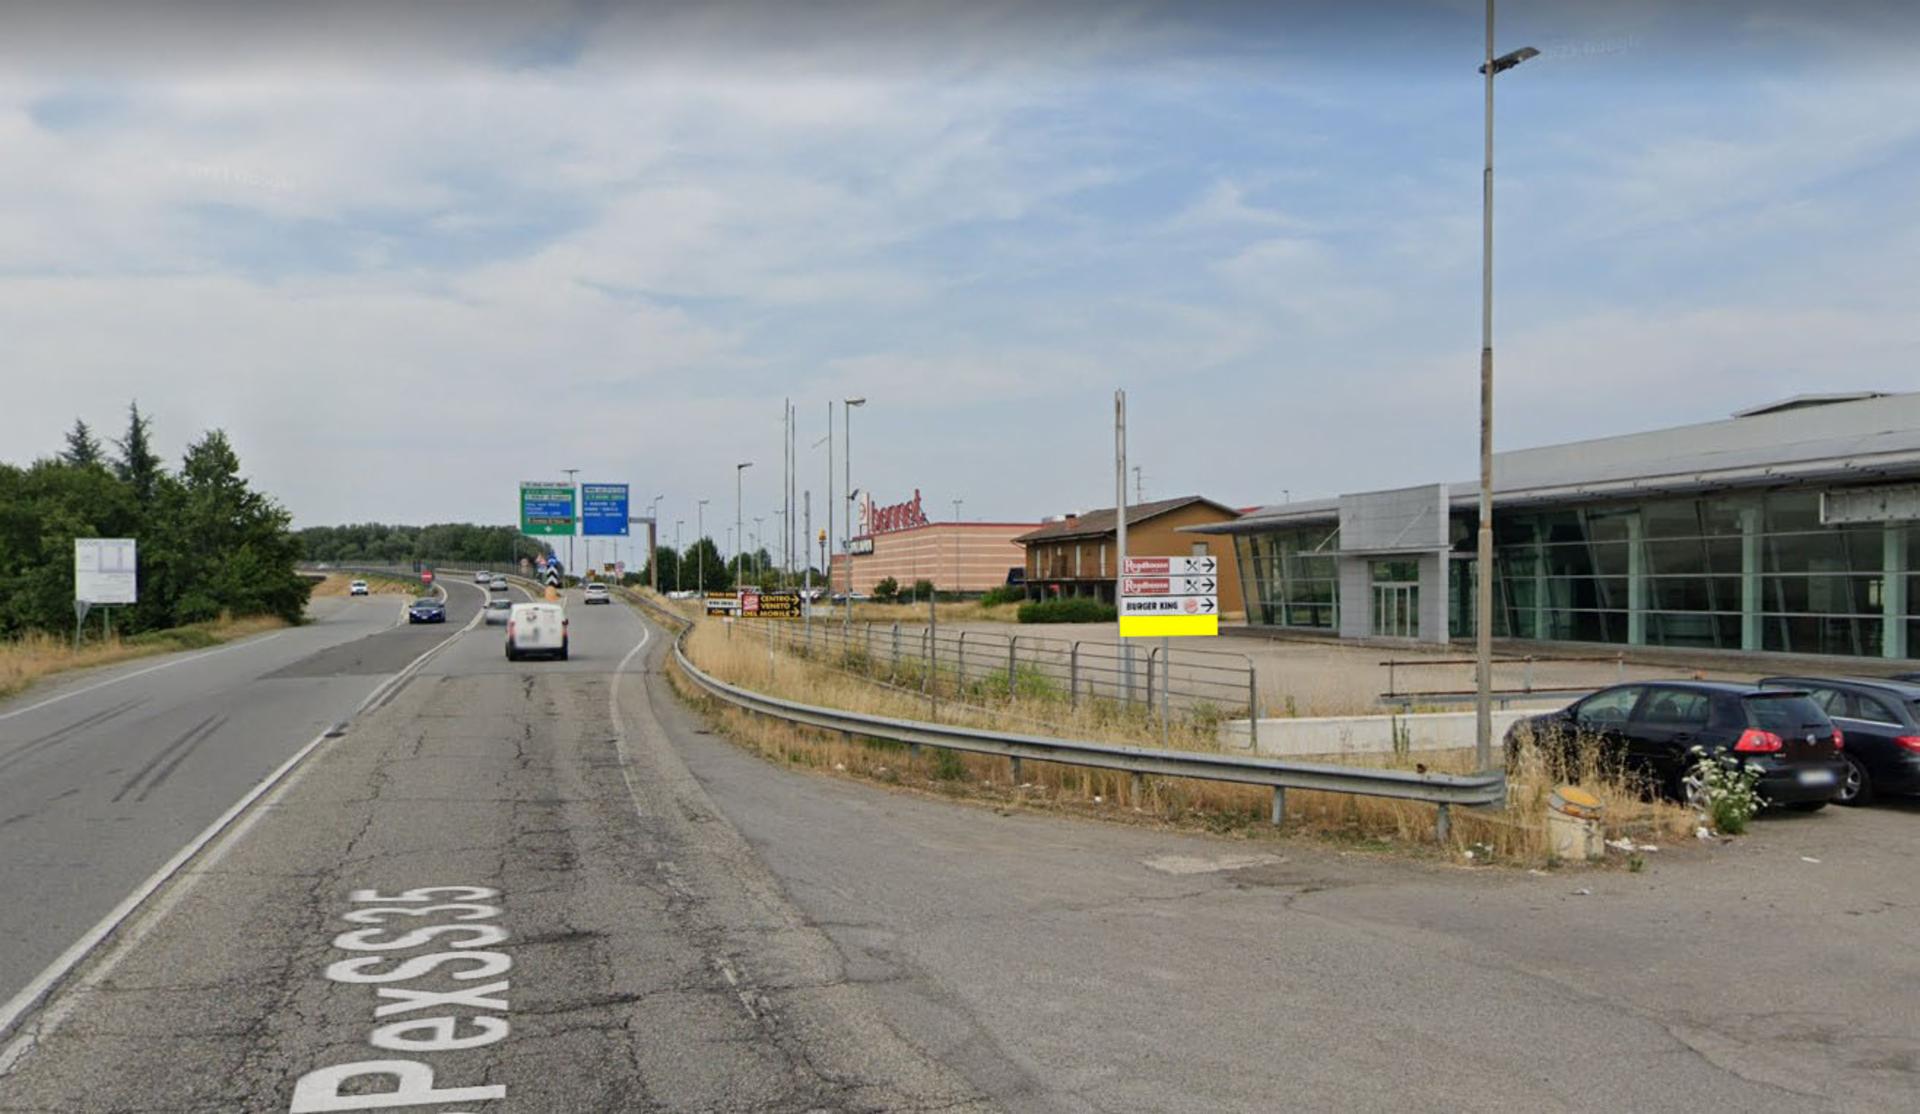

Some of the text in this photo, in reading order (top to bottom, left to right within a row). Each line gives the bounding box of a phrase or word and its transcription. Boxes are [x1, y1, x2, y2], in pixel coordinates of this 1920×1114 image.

[761, 595, 790, 603] CENTRO
[1126, 602, 1157, 611] BURGER
[1159, 601, 1178, 610] KING
